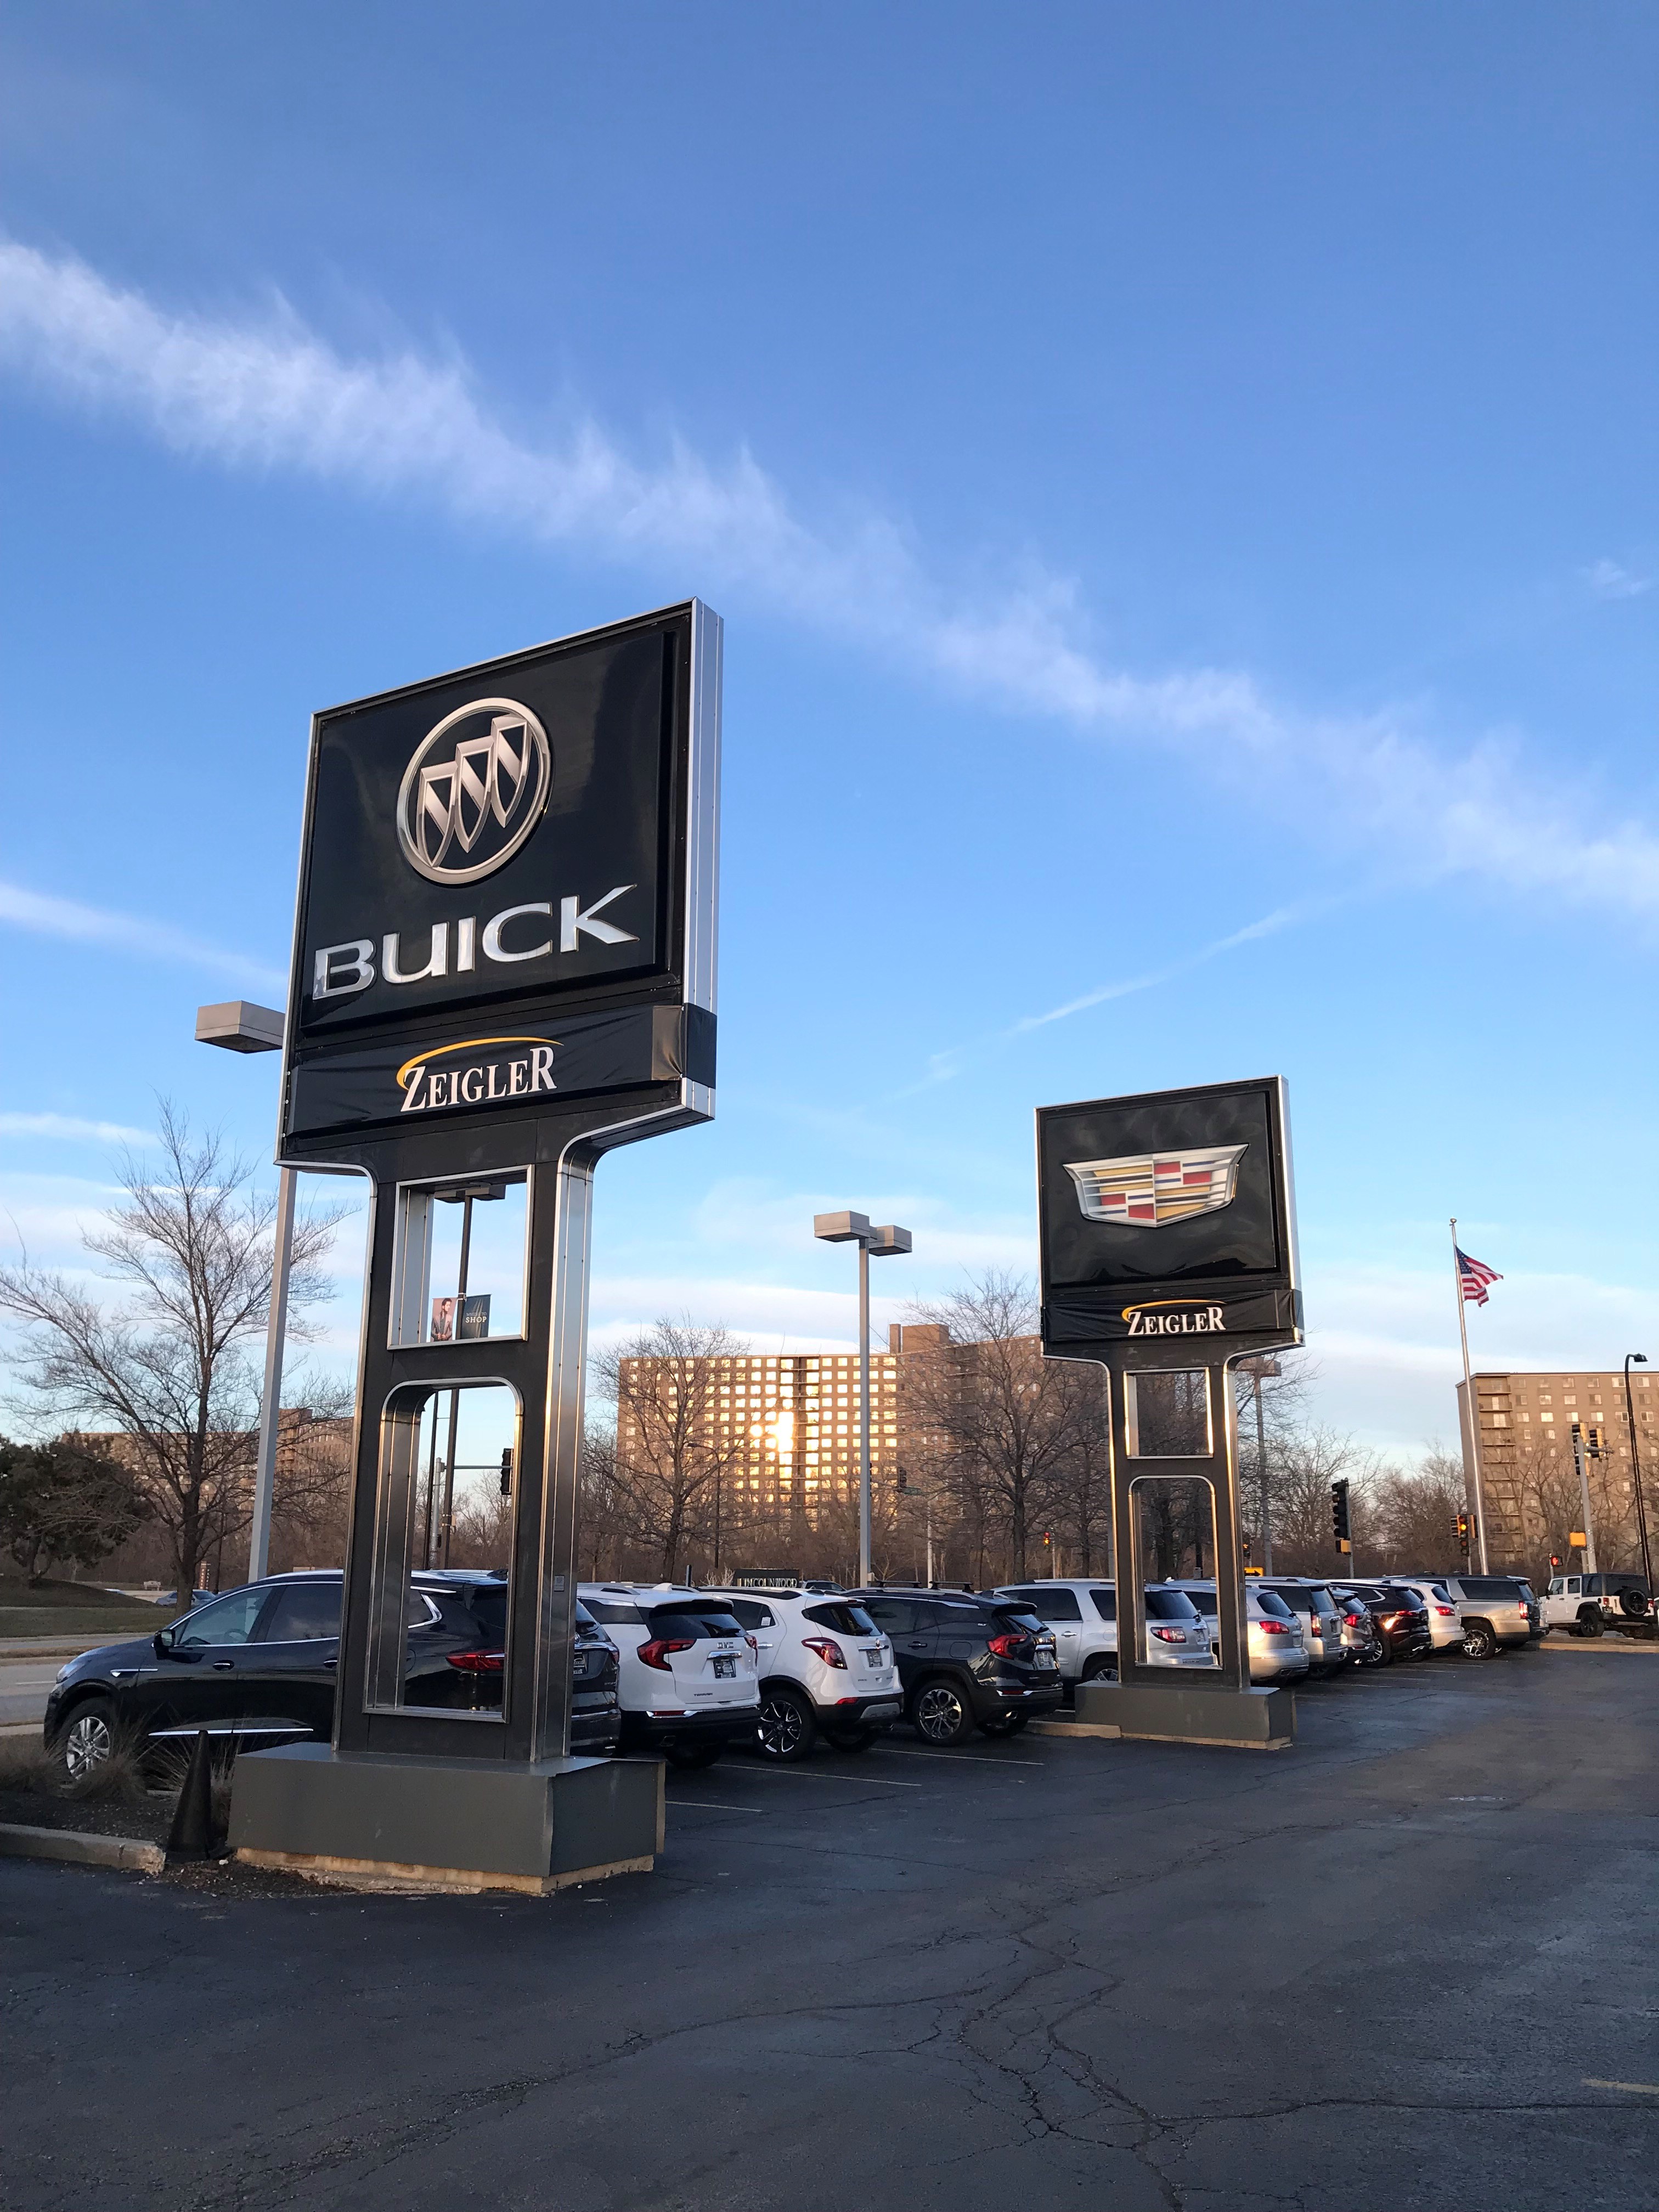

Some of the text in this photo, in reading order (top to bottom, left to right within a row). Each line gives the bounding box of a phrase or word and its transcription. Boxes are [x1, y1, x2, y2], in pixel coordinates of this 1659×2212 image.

[313, 884, 640, 1000] BUICK
[400, 1046, 557, 1112] ZEIGLER
[1128, 1307, 1226, 1335] ZEIGLER
